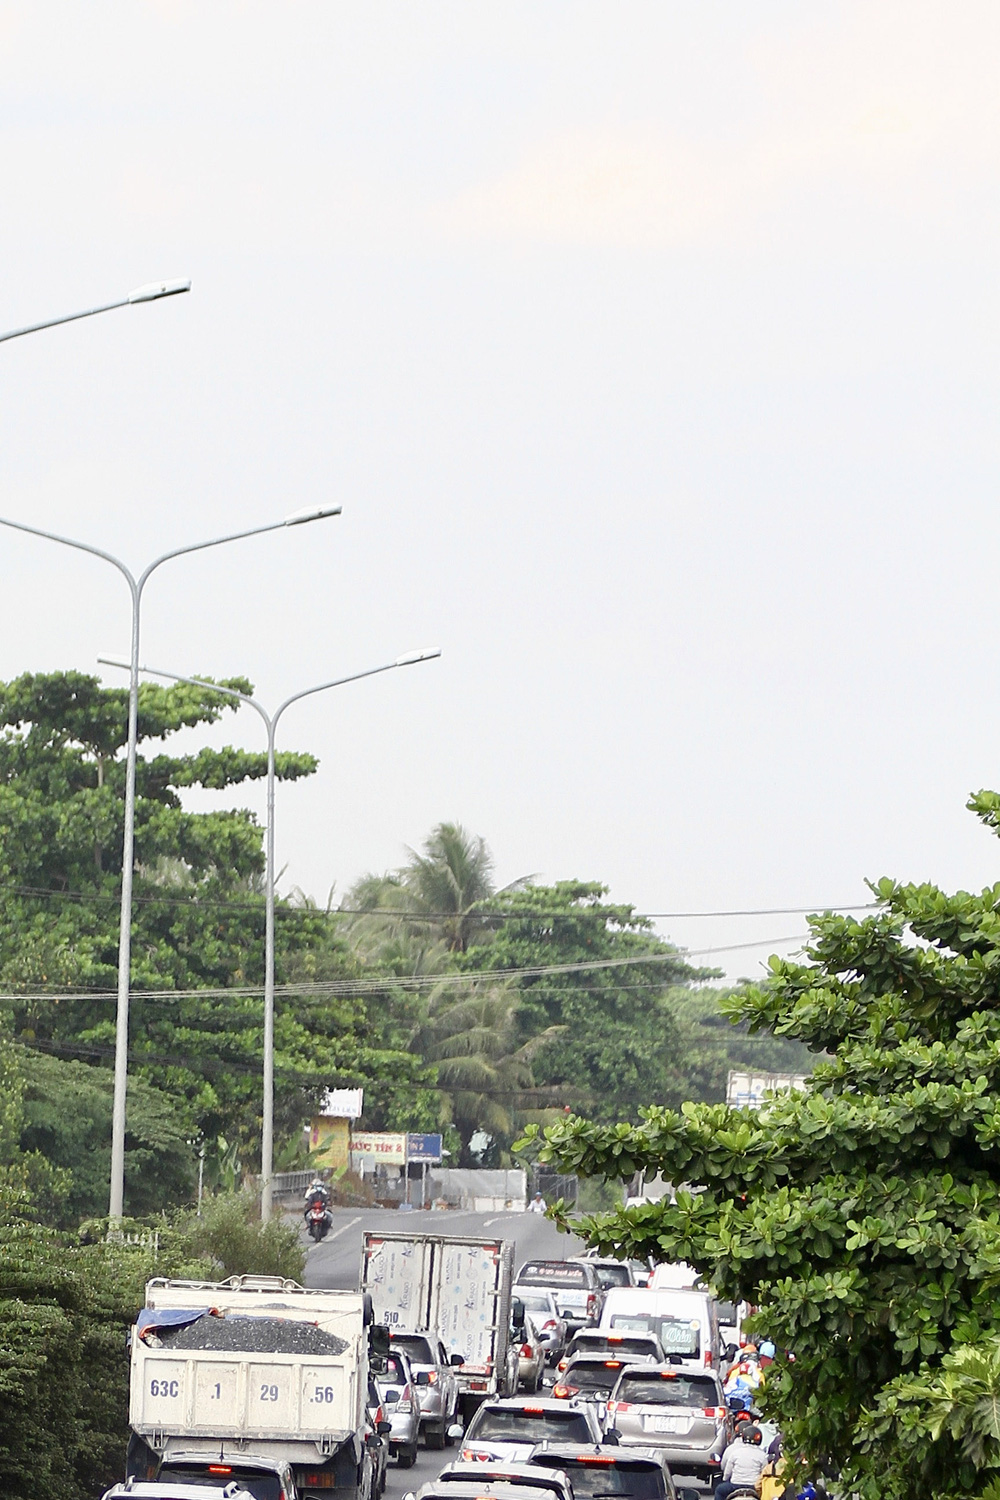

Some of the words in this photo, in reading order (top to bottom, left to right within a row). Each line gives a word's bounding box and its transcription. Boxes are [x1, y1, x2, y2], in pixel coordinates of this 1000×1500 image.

[384, 1311, 399, 1324] 51D
[150, 1379, 179, 1398] 63C
[259, 1384, 279, 1402] 29
[309, 1386, 334, 1404] .56
